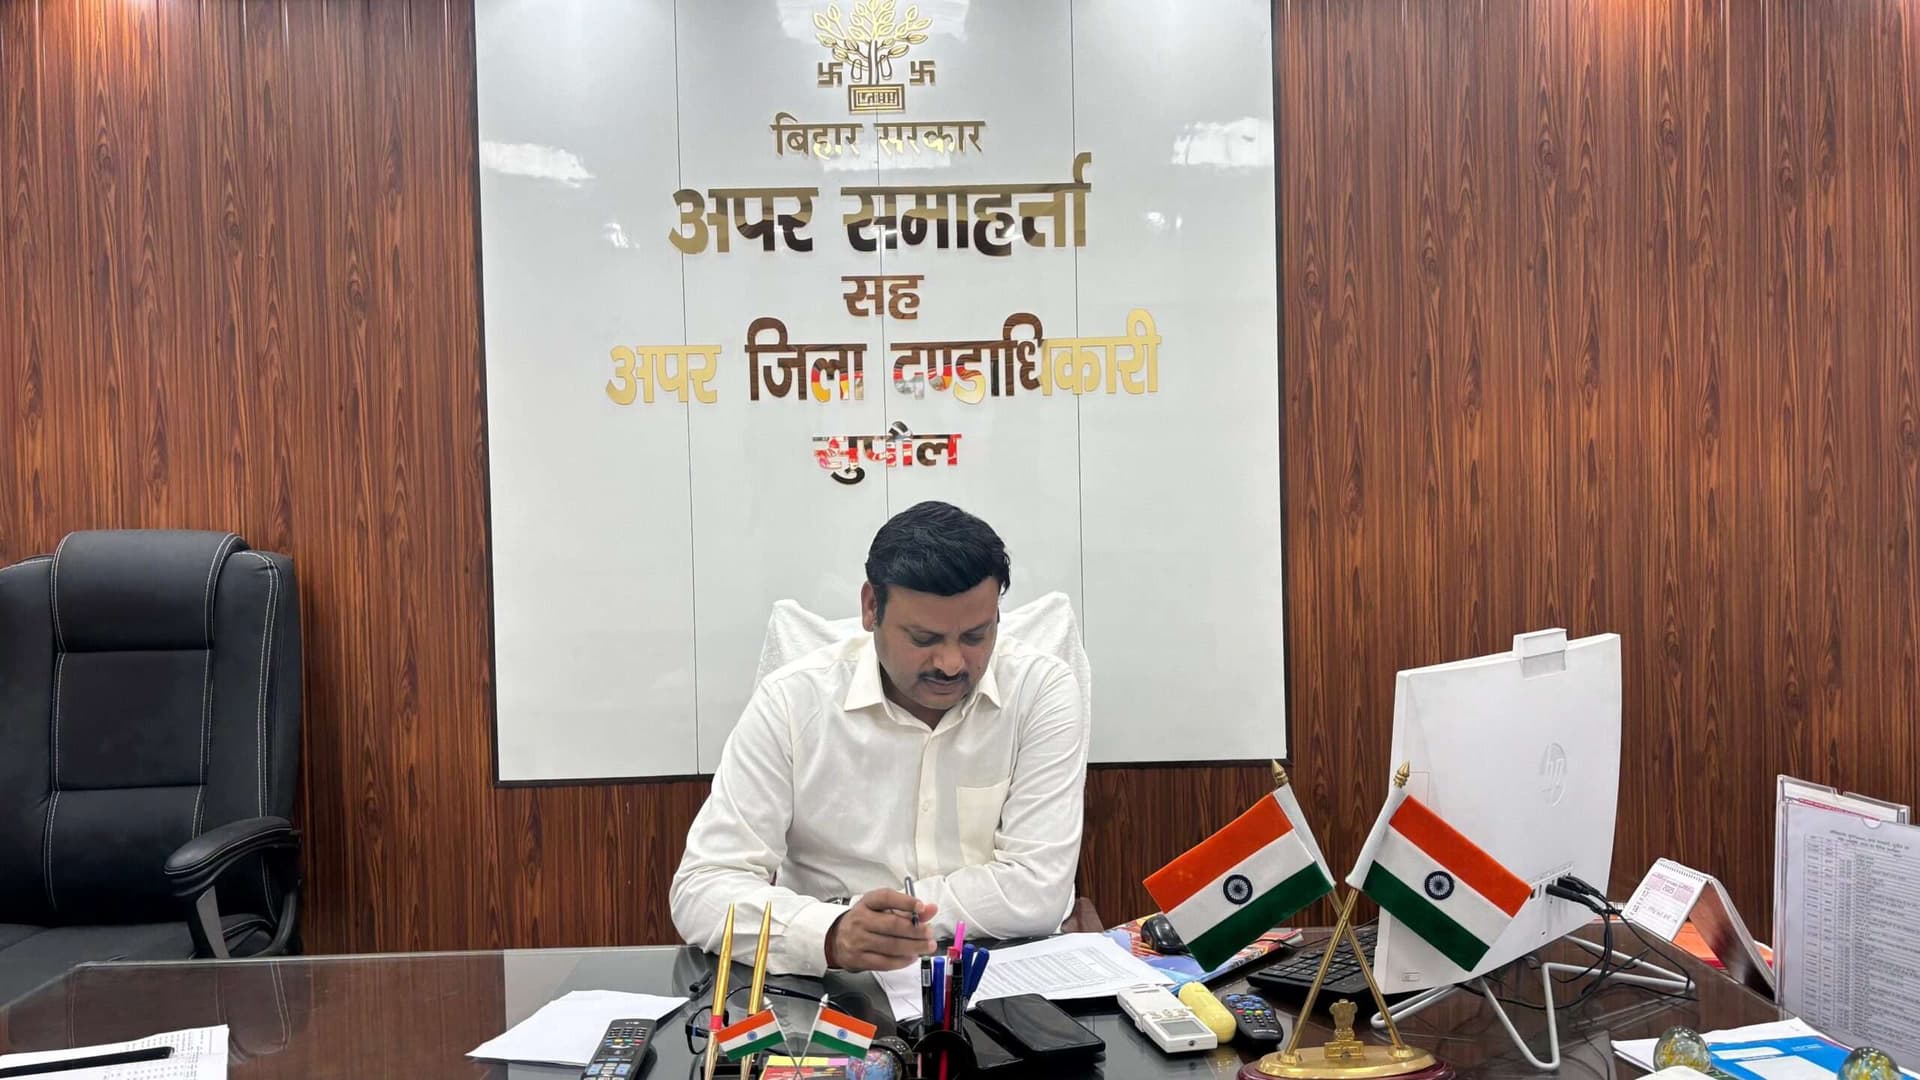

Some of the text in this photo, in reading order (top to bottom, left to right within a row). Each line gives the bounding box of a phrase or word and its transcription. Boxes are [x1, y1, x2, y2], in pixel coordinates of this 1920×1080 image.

[770, 112, 986, 159] बिहार सरकार
[669, 186, 818, 254] अपर
[841, 275, 924, 319] सह
[605, 308, 1161, 404] अपर जिला दण्डाधिकारी
[812, 421, 962, 485] सुपौल
